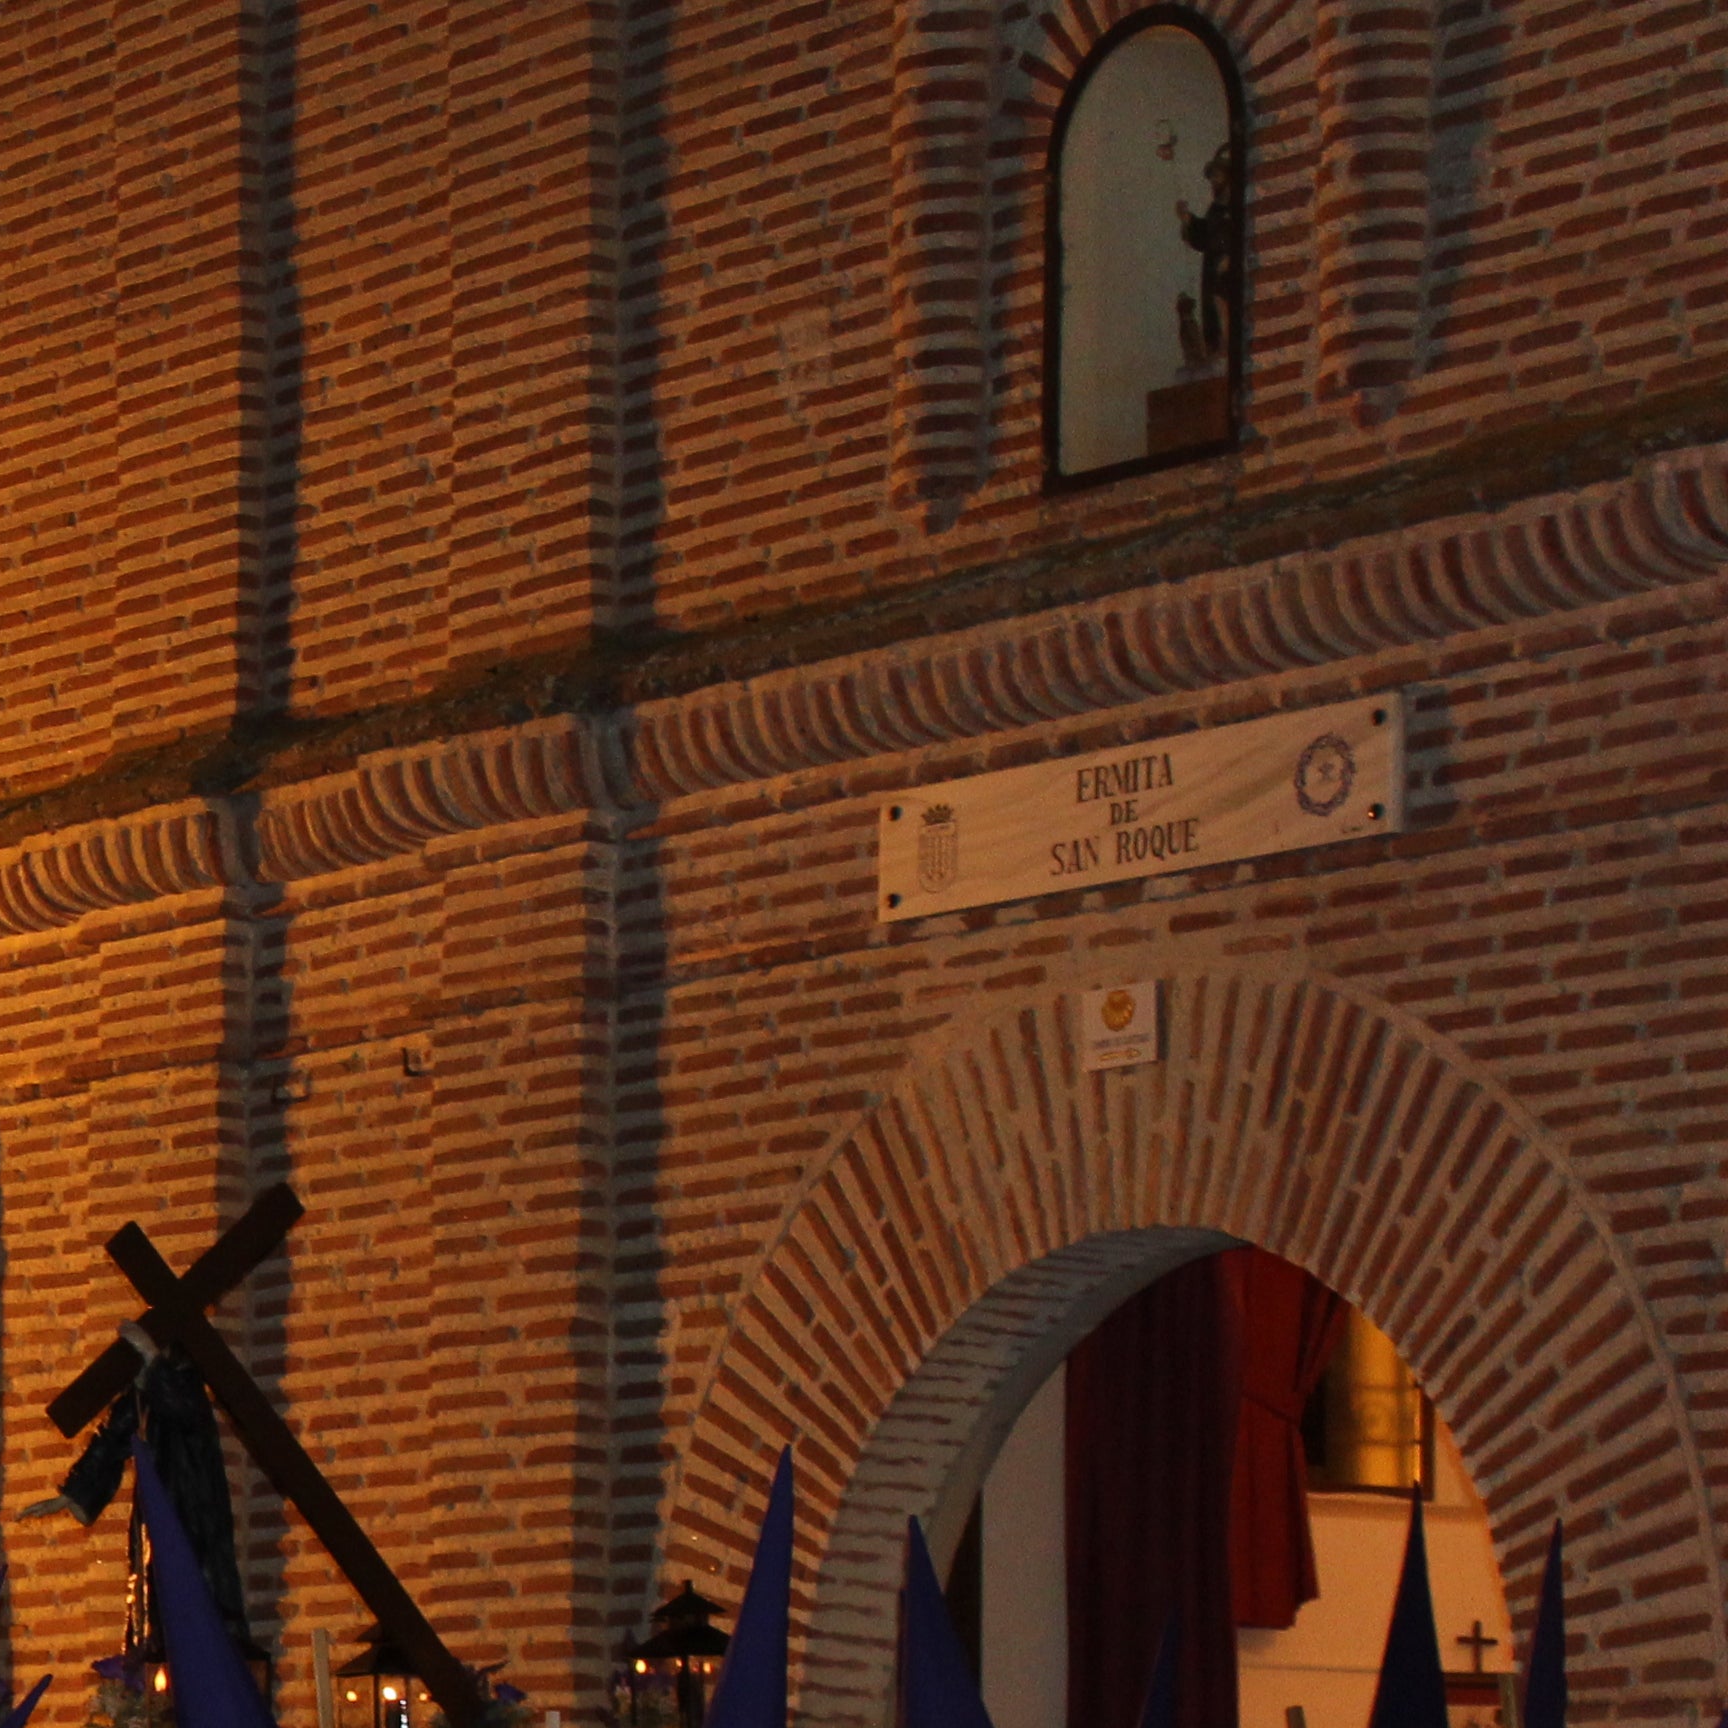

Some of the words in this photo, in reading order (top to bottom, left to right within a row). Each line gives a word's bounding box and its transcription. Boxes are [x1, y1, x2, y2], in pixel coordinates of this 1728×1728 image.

[1076, 753, 1175, 803] ERMITA
[1109, 799, 1139, 826] DE
[1049, 835, 1101, 877] SAN
[1116, 817, 1199, 865] ROQUE
